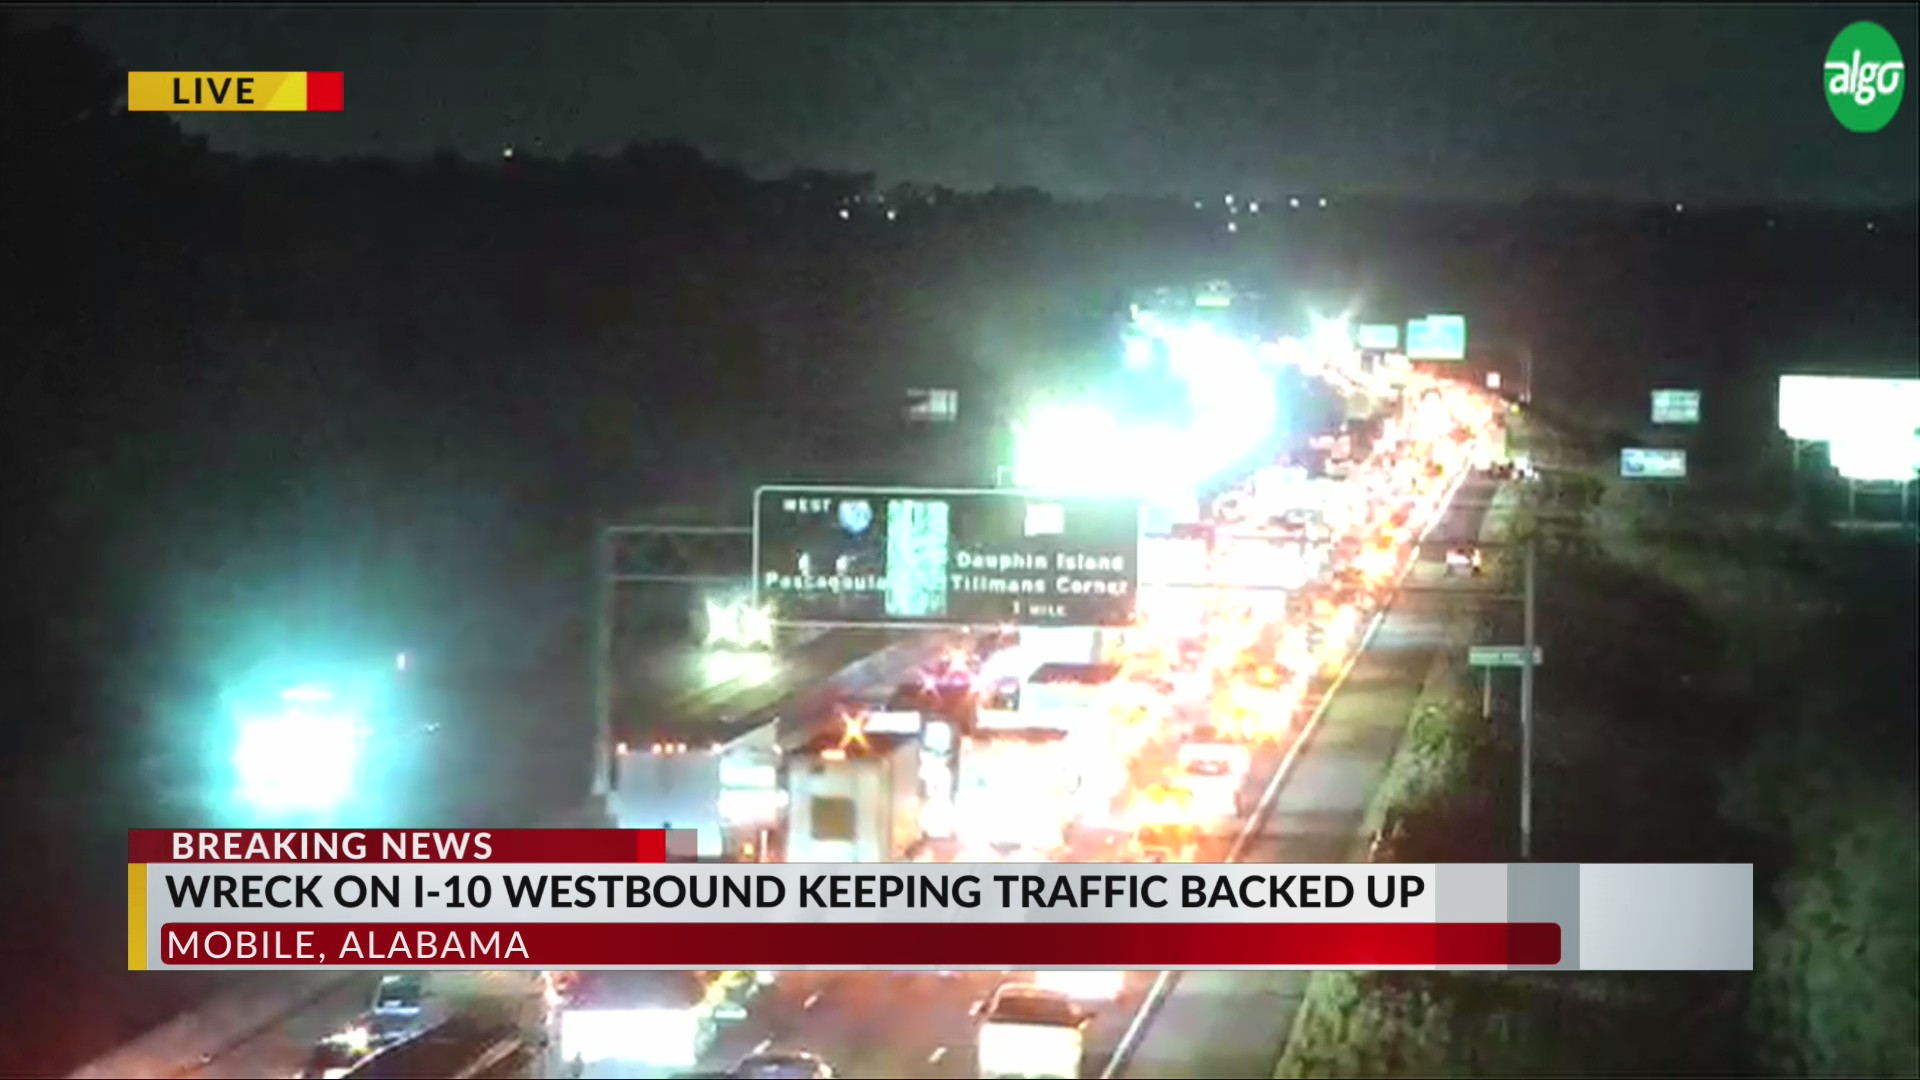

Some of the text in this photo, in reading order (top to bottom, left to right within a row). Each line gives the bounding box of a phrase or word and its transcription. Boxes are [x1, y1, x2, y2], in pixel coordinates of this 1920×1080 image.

[782, 499, 831, 513] WEST
[956, 550, 1124, 572] Dauphin Island
[952, 574, 1128, 596] Tillmans Corner
